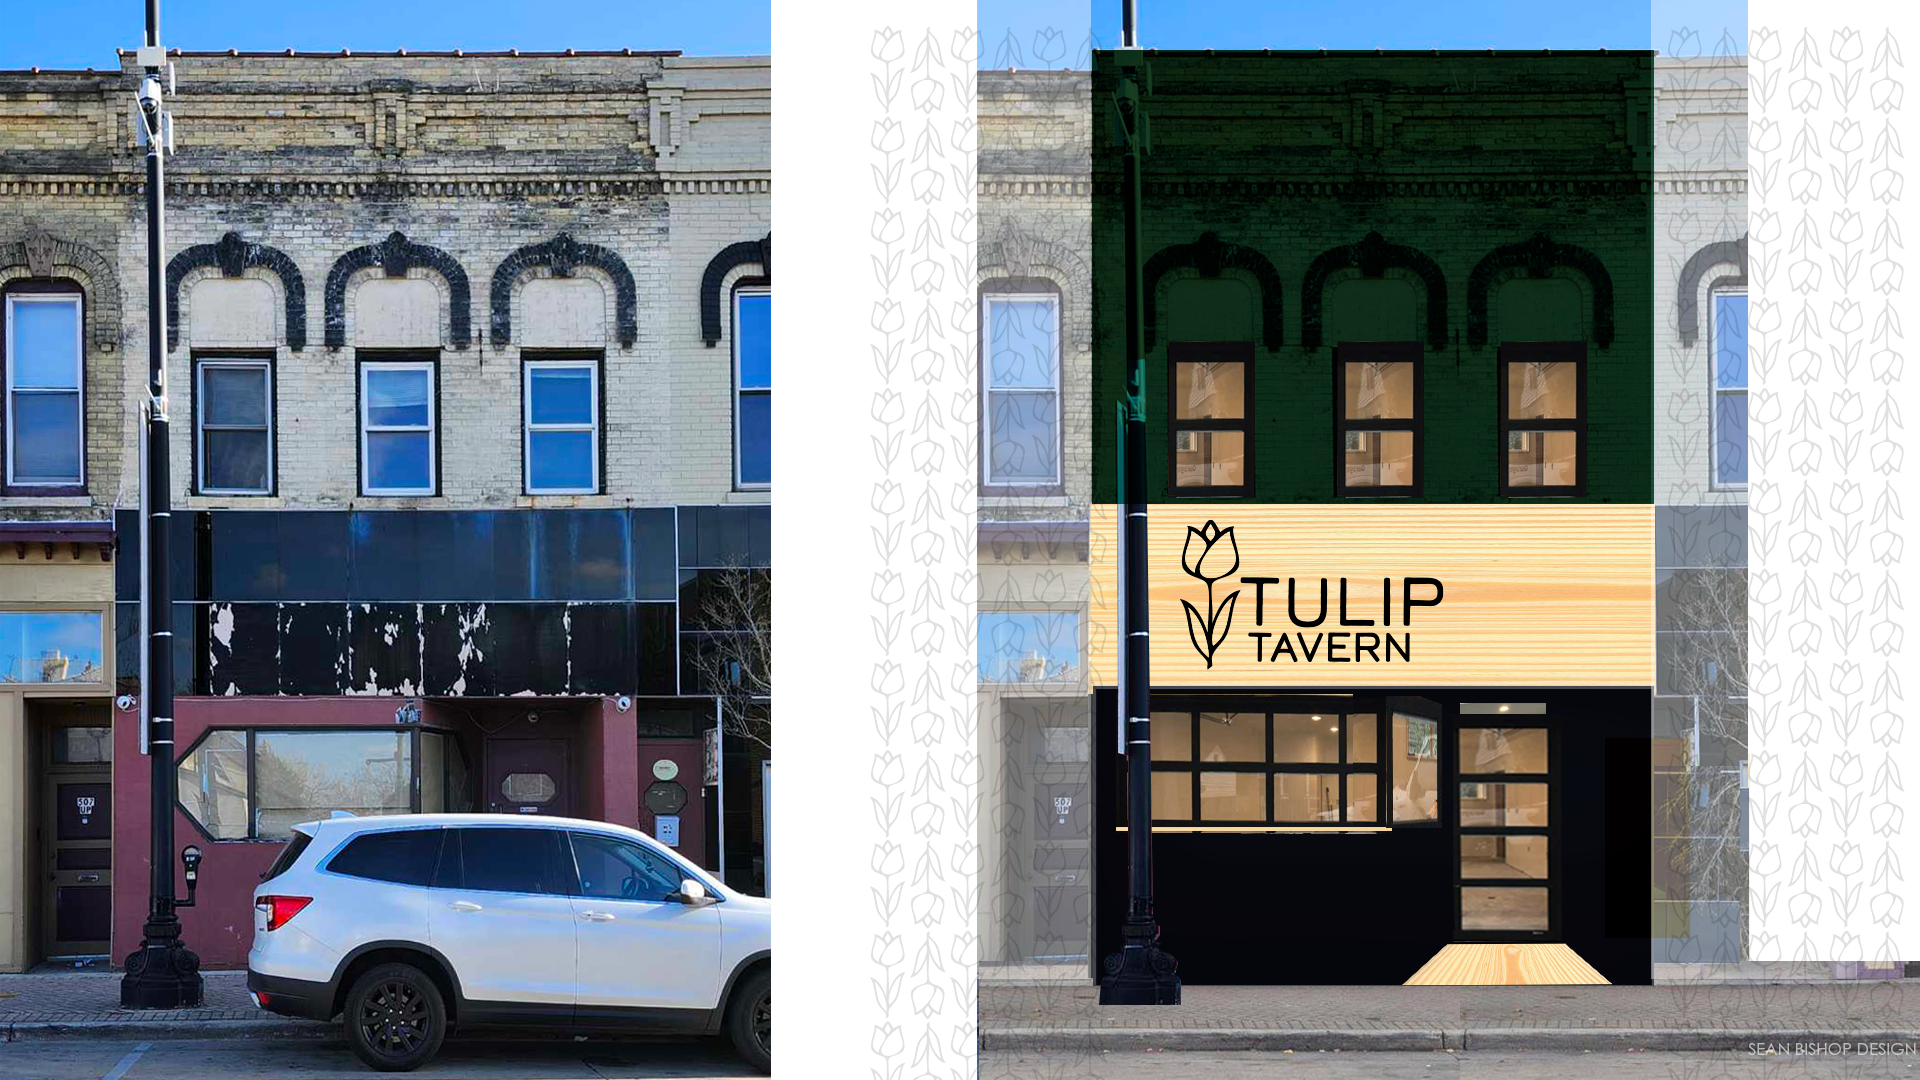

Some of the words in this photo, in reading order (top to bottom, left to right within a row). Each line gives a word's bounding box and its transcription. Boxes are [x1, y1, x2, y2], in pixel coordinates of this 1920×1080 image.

[1240, 577, 1444, 627] TULIP
[1248, 632, 1410, 662] TAVERN
[78, 798, 94, 806] 507
[1055, 798, 1071, 806] 507
[80, 806, 92, 814] UP
[1057, 806, 1069, 814] UP
